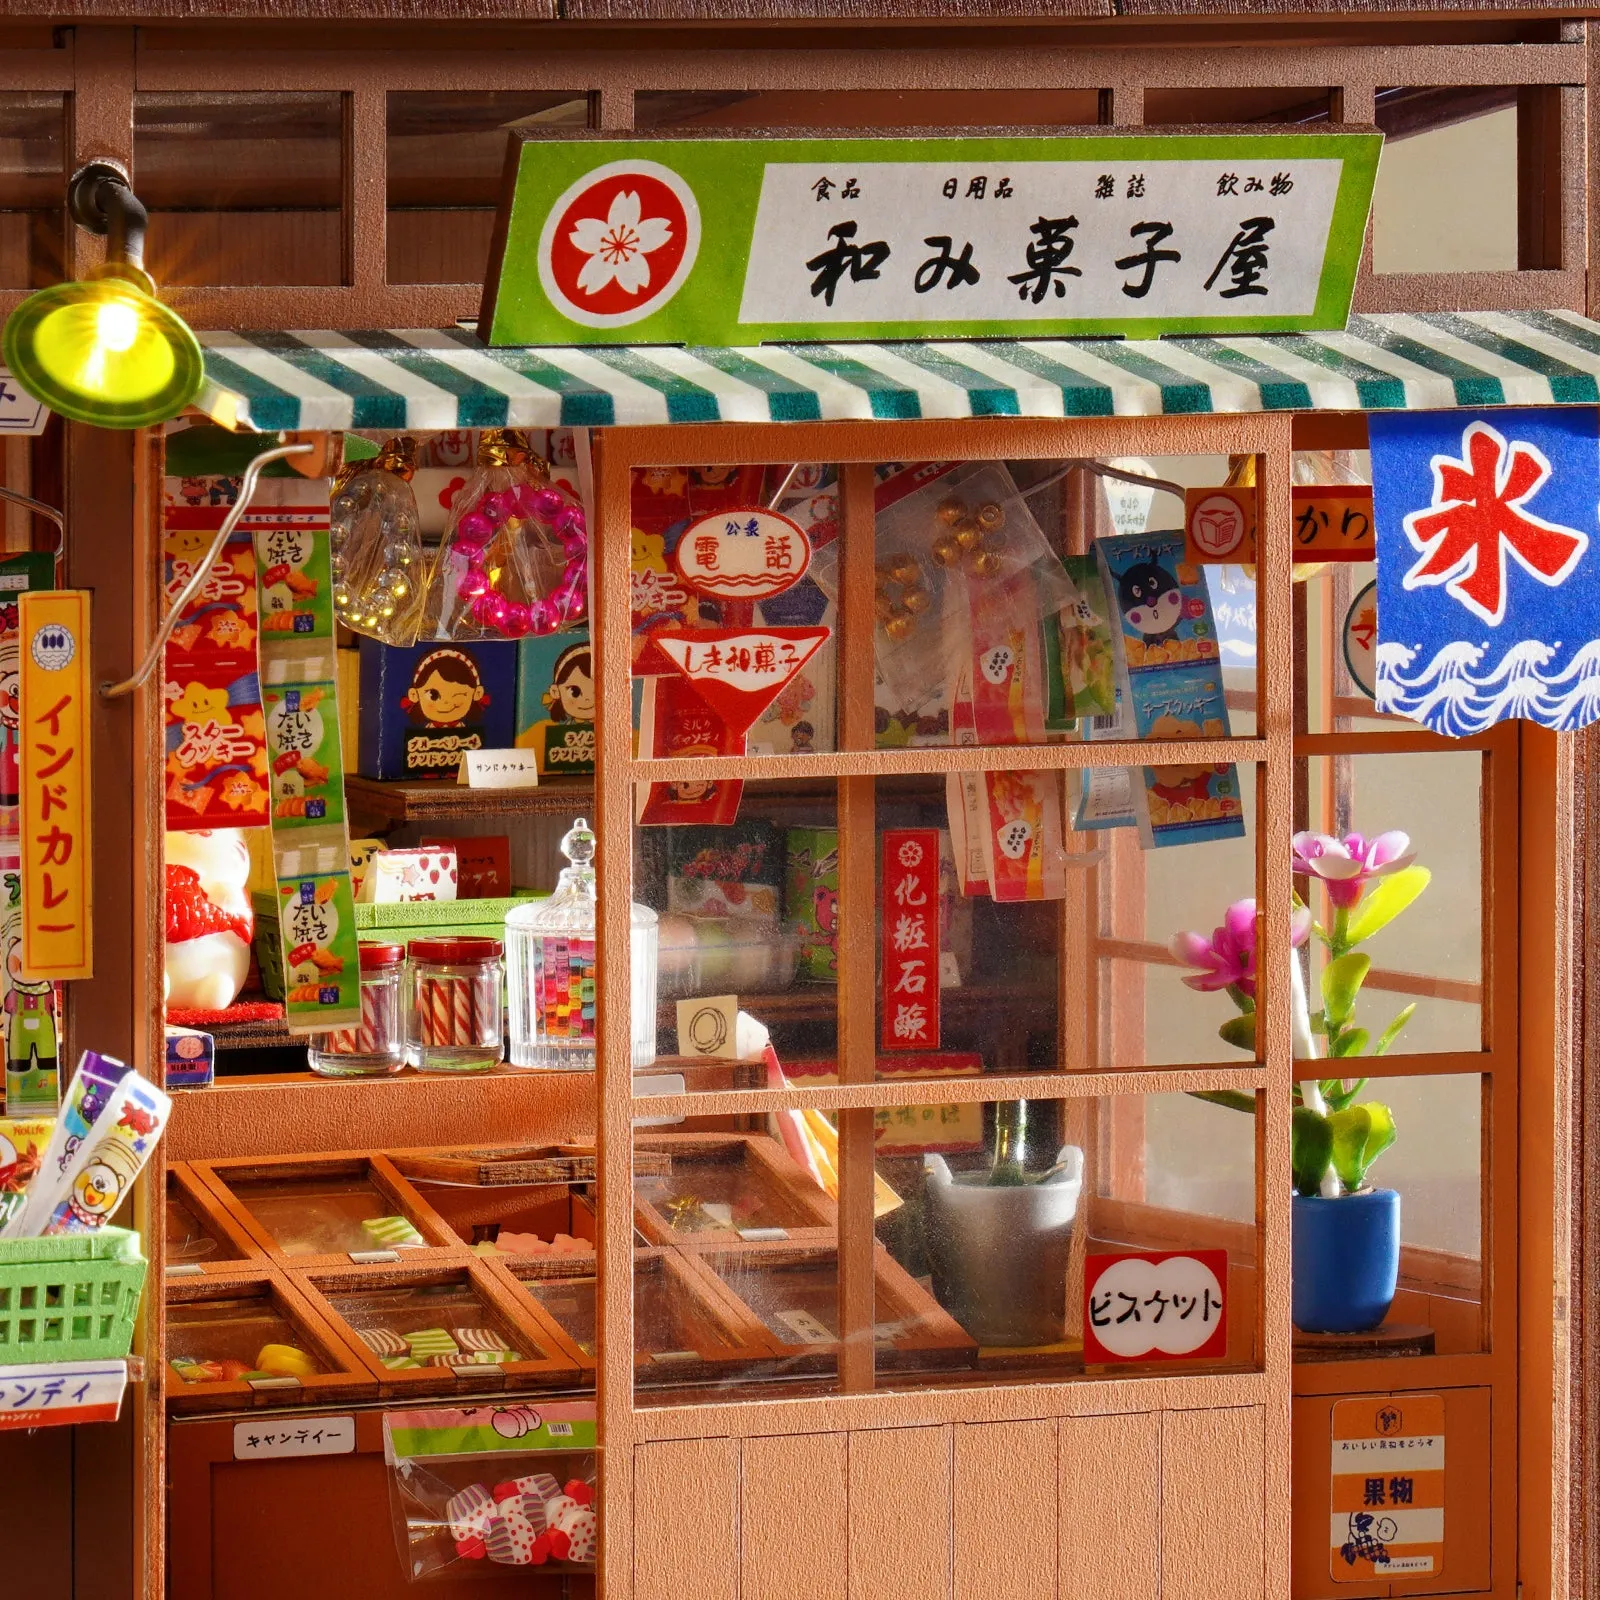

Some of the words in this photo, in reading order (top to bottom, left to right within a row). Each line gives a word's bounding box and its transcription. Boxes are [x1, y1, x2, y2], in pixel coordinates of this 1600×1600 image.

[810, 176, 862, 201] 食品
[941, 175, 1014, 200] 日用品
[1215, 172, 1295, 197] 飲み物
[806, 216, 1276, 307] 和み菓子屋
[724, 518, 761, 537] 公衆
[1402, 420, 1590, 627] 氷
[694, 535, 792, 570] 電話
[175, 562, 232, 578] スー
[408, 752, 464, 768] サンドクッ
[549, 750, 595, 764] サンドク
[35, 694, 75, 932] インドカレー
[292, 904, 326, 921] たい
[292, 921, 328, 943] 焼き
[1090, 1288, 1222, 1327] ビスケット
[1363, 1476, 1415, 1506] 果物
